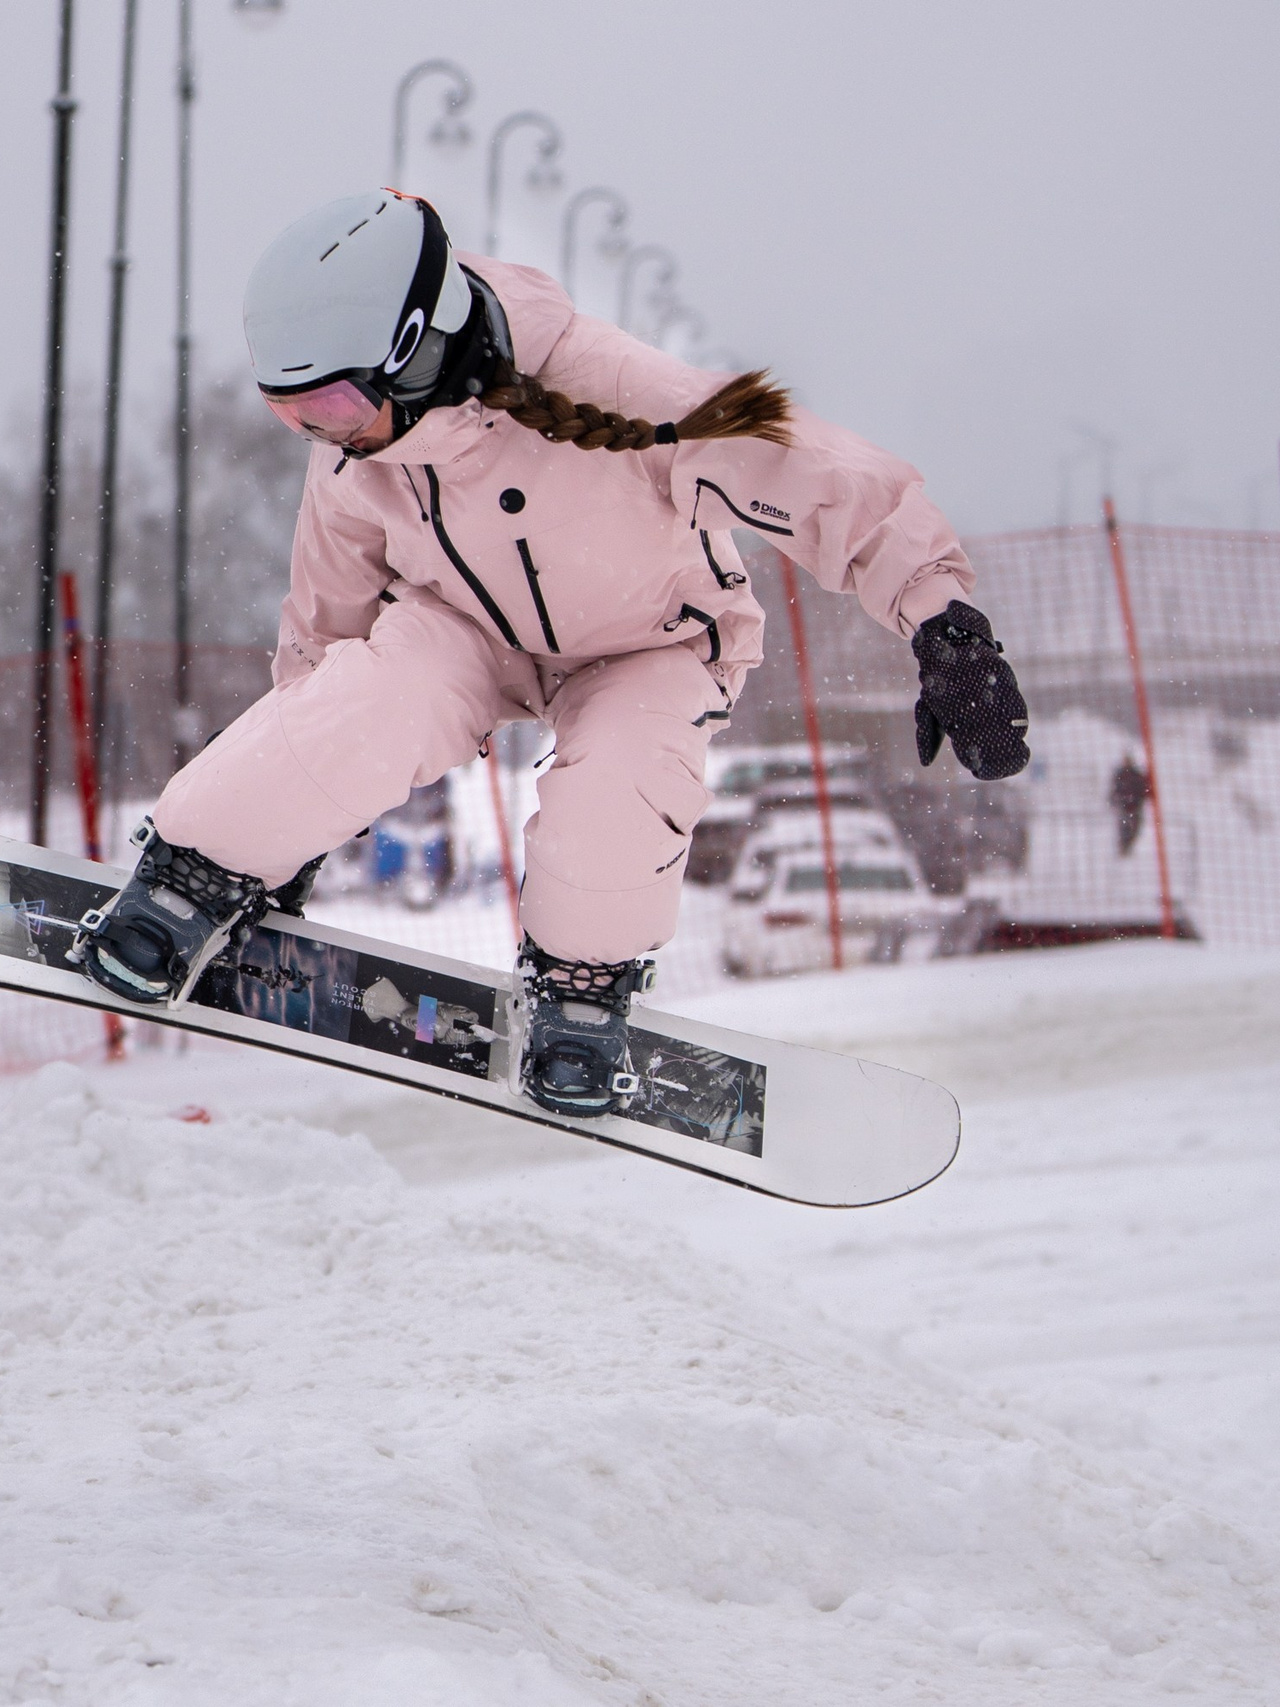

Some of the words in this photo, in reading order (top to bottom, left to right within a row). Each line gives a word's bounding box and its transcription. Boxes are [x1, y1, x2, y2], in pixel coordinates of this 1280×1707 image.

[761, 503, 791, 518] Ditex
[333, 982, 376, 998] SCOUT
[331, 998, 375, 1013] BURTON
[333, 990, 375, 1006] TALENT
